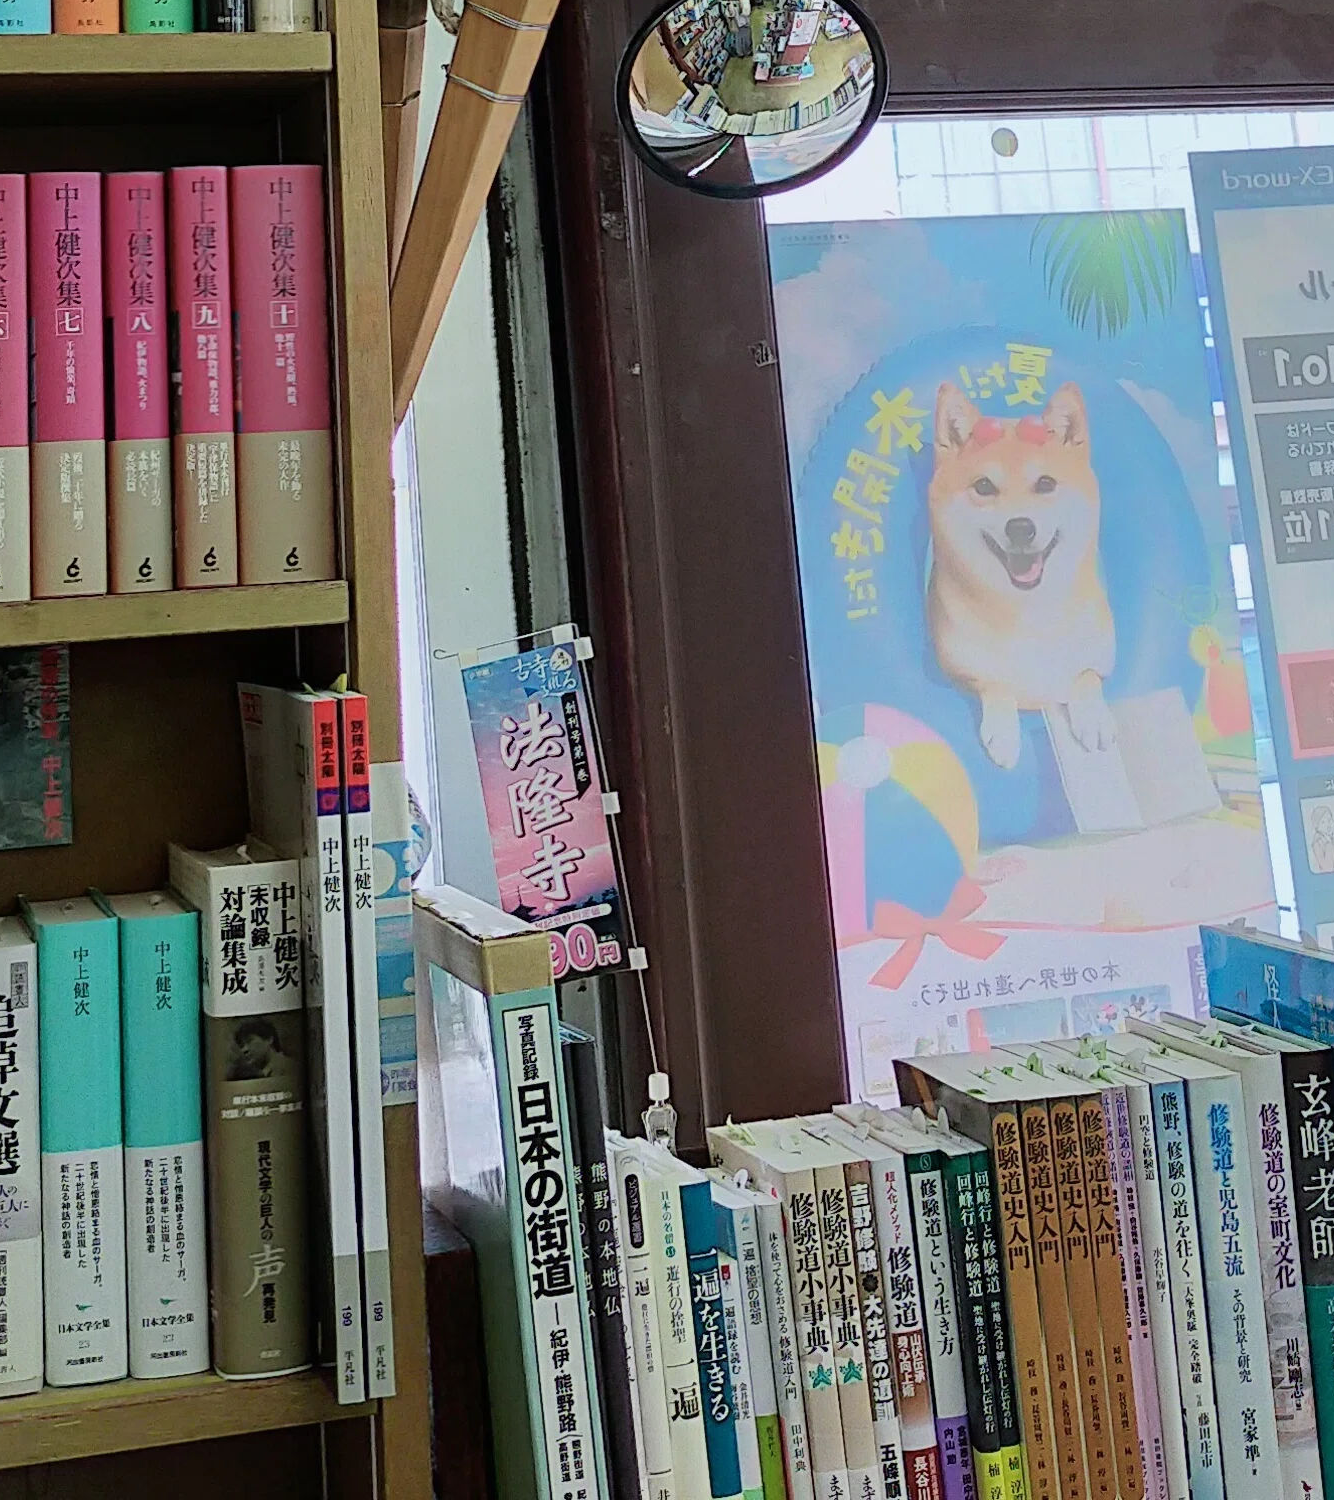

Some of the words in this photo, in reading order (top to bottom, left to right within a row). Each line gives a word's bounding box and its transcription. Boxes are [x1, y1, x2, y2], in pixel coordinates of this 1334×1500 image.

[54, 182, 82, 306] 中上健次集
[127, 185, 154, 306] 中上健次集
[190, 176, 218, 298] 中上健次集
[268, 176, 298, 298] 中上健次集
[499, 702, 586, 901] 法隆寺
[219, 886, 248, 996] 対論集成
[271, 881, 299, 989] 中上健次
[322, 837, 342, 913] 中上健次
[353, 835, 373, 911] 中上健次
[72, 945, 91, 1019] 中上健次
[154, 940, 173, 1012] 中上健次
[518, 1014, 540, 1081] 写真記録
[517, 1082, 576, 1300] 日本の街道
[589, 1161, 622, 1317] 熊野の本地仏
[956, 1173, 984, 1298] 回峰行と修験道
[975, 1170, 1001, 1294] 回峰行と修験道
[994, 1120, 1031, 1271] 修験道史入門
[1024, 1116, 1060, 1265] 修験道史入門
[1053, 1111, 1089, 1261] 修験道史入門
[1082, 1107, 1117, 1259] 修験道史入門
[1160, 1092, 1193, 1279] 熊野、修験の道を往く
[1207, 1103, 1246, 1278] 修験道と児島五流
[1258, 1102, 1297, 1291] 修験道の室町文化
[788, 1191, 831, 1356] 修験道小事典
[820, 1187, 861, 1349] 修験道小事典
[887, 1246, 919, 1329] 修験道
[920, 1178, 954, 1358] 修験道という生き方
[690, 1251, 731, 1423] 一遍を生きる
